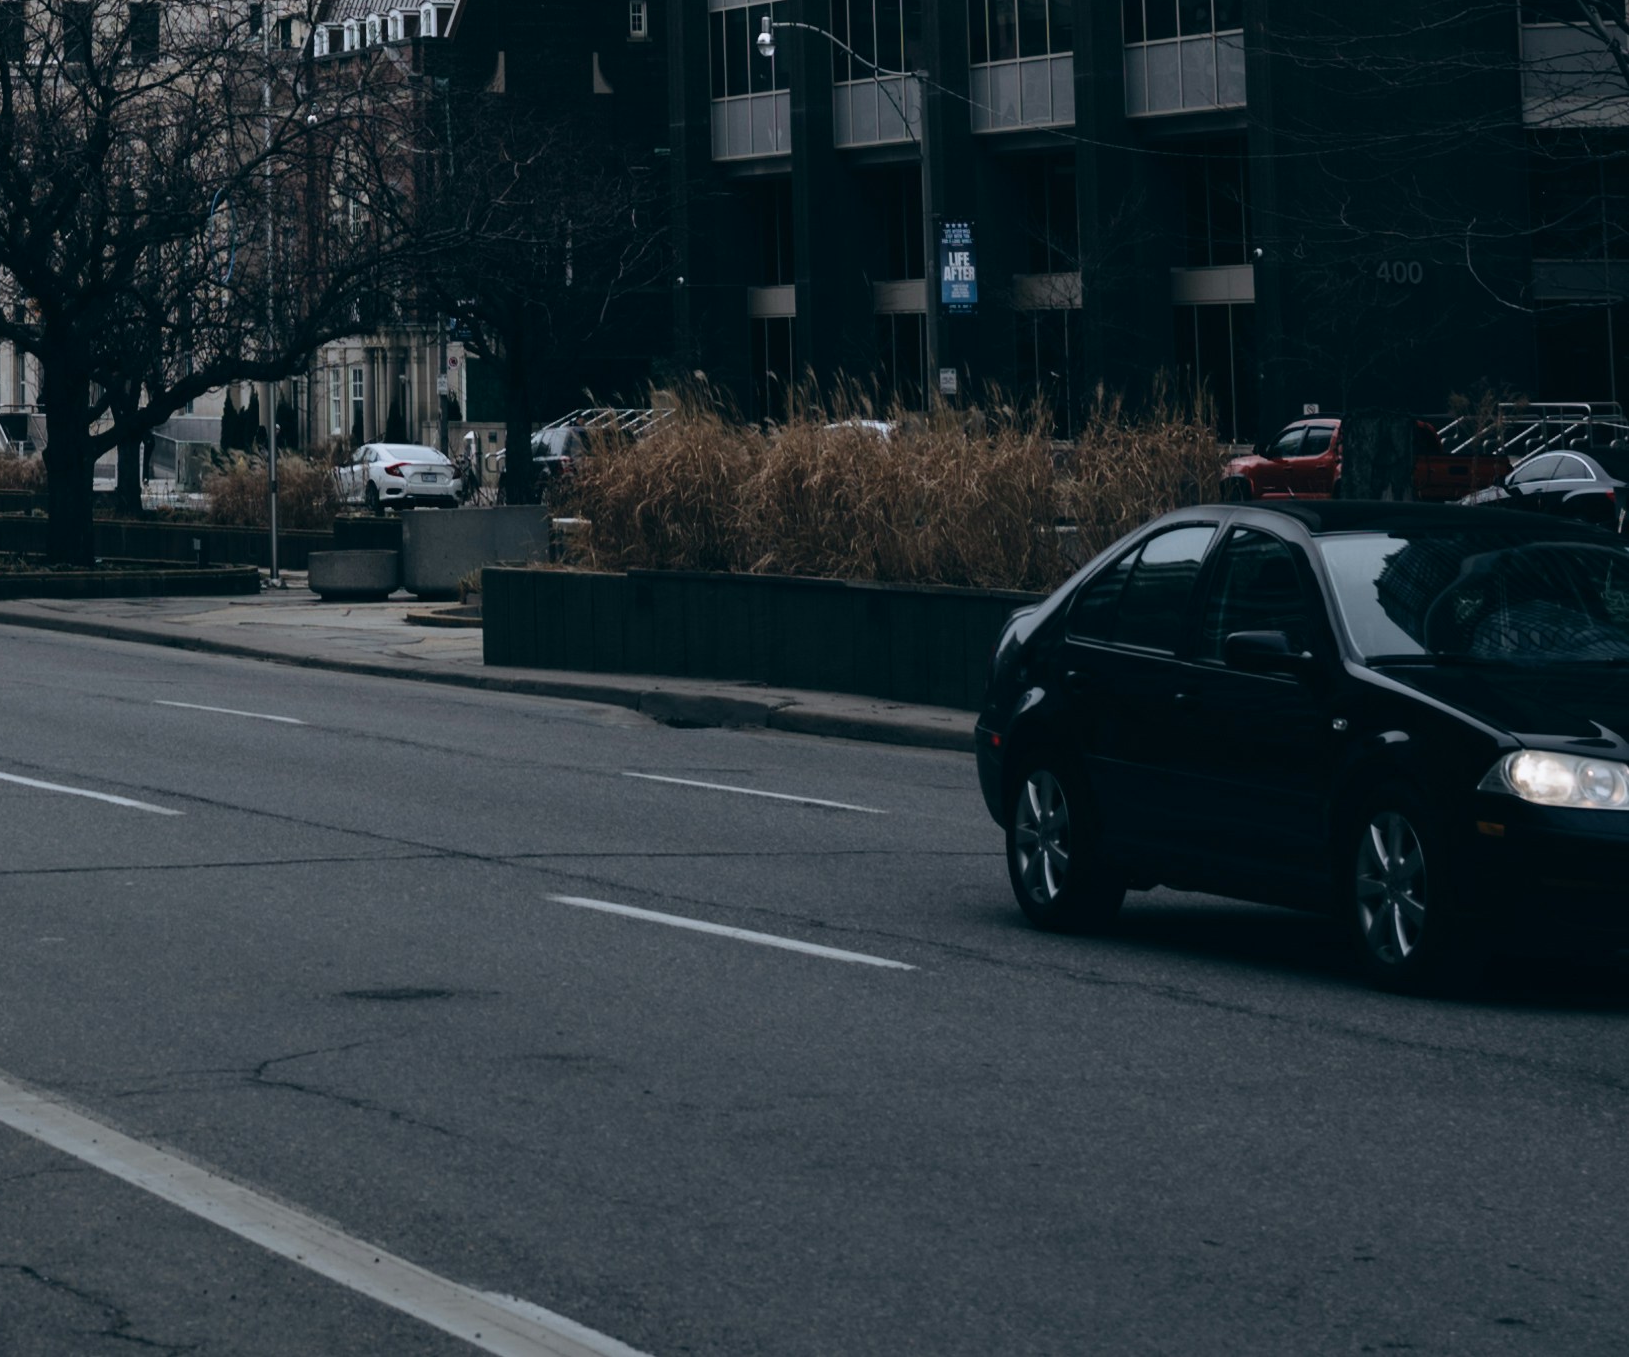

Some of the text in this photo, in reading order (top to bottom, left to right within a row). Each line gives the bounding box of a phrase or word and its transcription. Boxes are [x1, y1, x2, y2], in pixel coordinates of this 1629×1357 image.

[948, 251, 970, 266] LIFE
[944, 266, 975, 281] AFTER
[1376, 260, 1423, 284] 400
